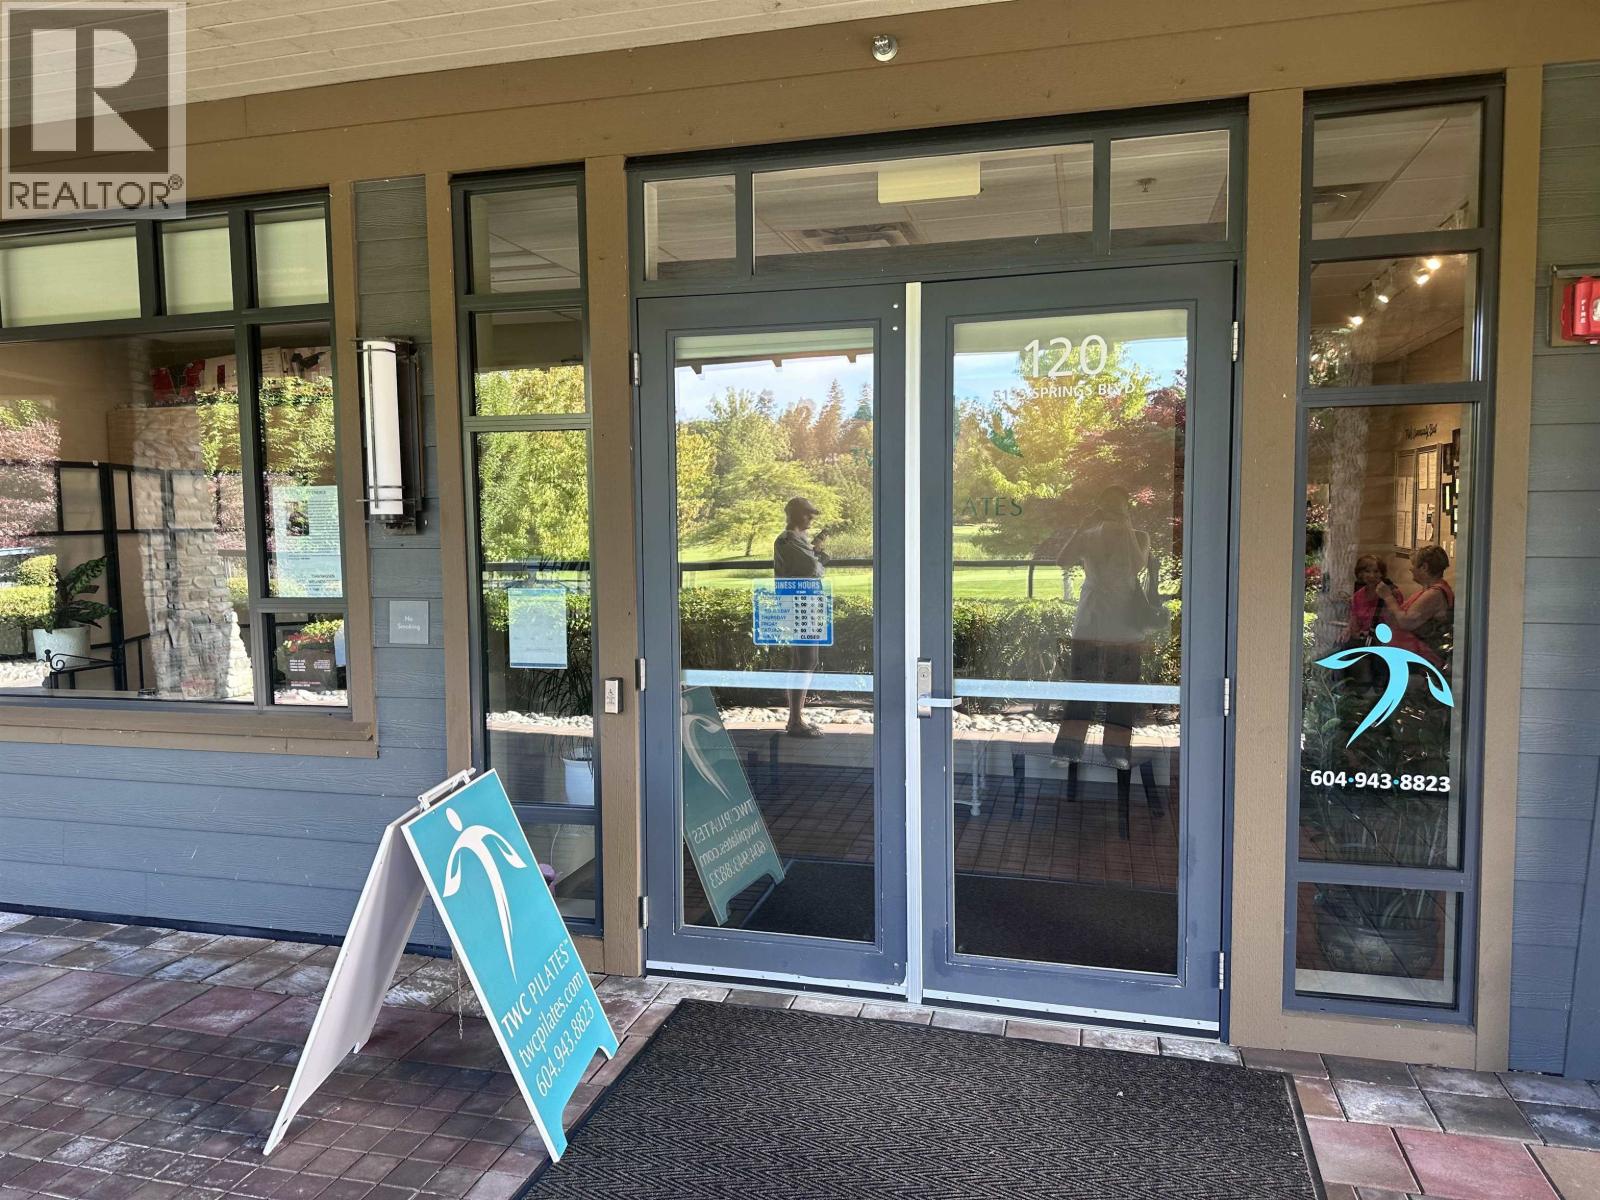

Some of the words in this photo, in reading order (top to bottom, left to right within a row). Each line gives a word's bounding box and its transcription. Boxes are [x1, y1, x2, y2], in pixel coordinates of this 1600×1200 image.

[1024, 334, 1108, 378] 120
[1033, 384, 1093, 399] SPRINGS
[1098, 383, 1136, 396] BLVD
[797, 581, 820, 590] HOURS
[500, 991, 533, 1039] TWC
[518, 971, 584, 1069] twcpilates.com
[535, 998, 596, 1098] 604.943.8823
